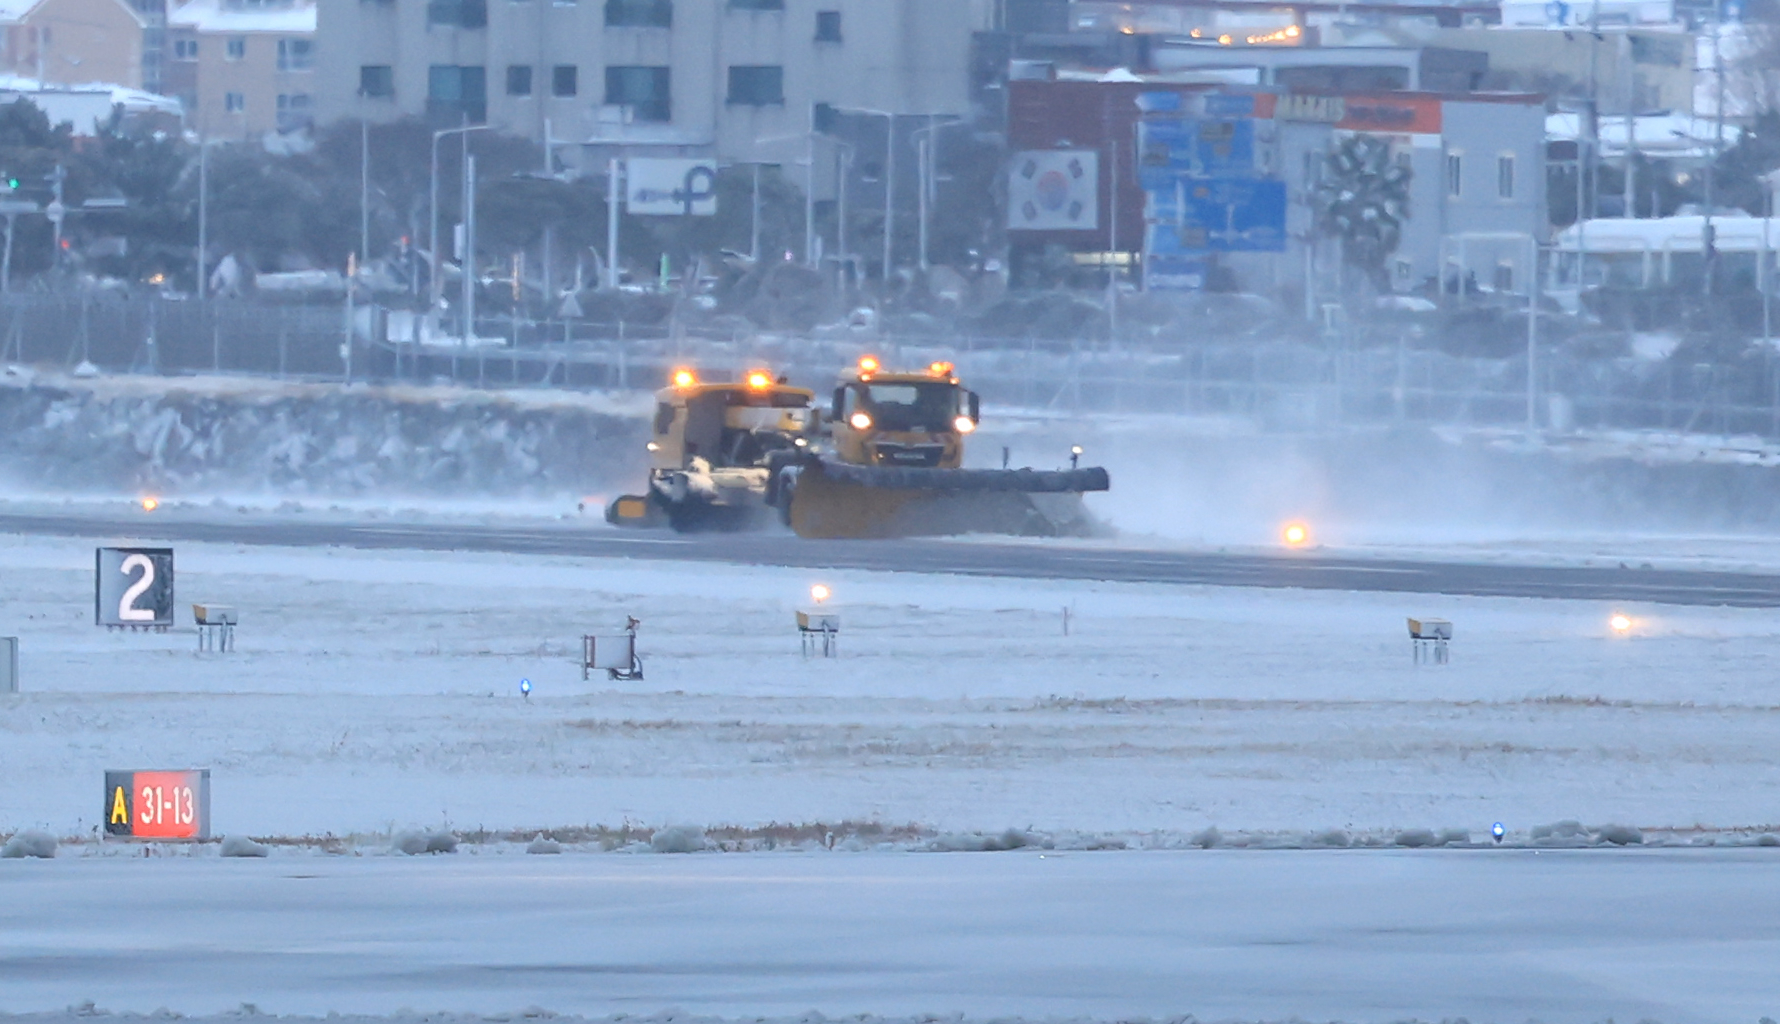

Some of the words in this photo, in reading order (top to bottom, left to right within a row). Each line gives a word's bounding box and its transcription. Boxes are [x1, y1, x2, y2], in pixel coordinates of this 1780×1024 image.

[118, 553, 155, 621] 2
[110, 785, 128, 825] A
[140, 785, 194, 825] 31-13
